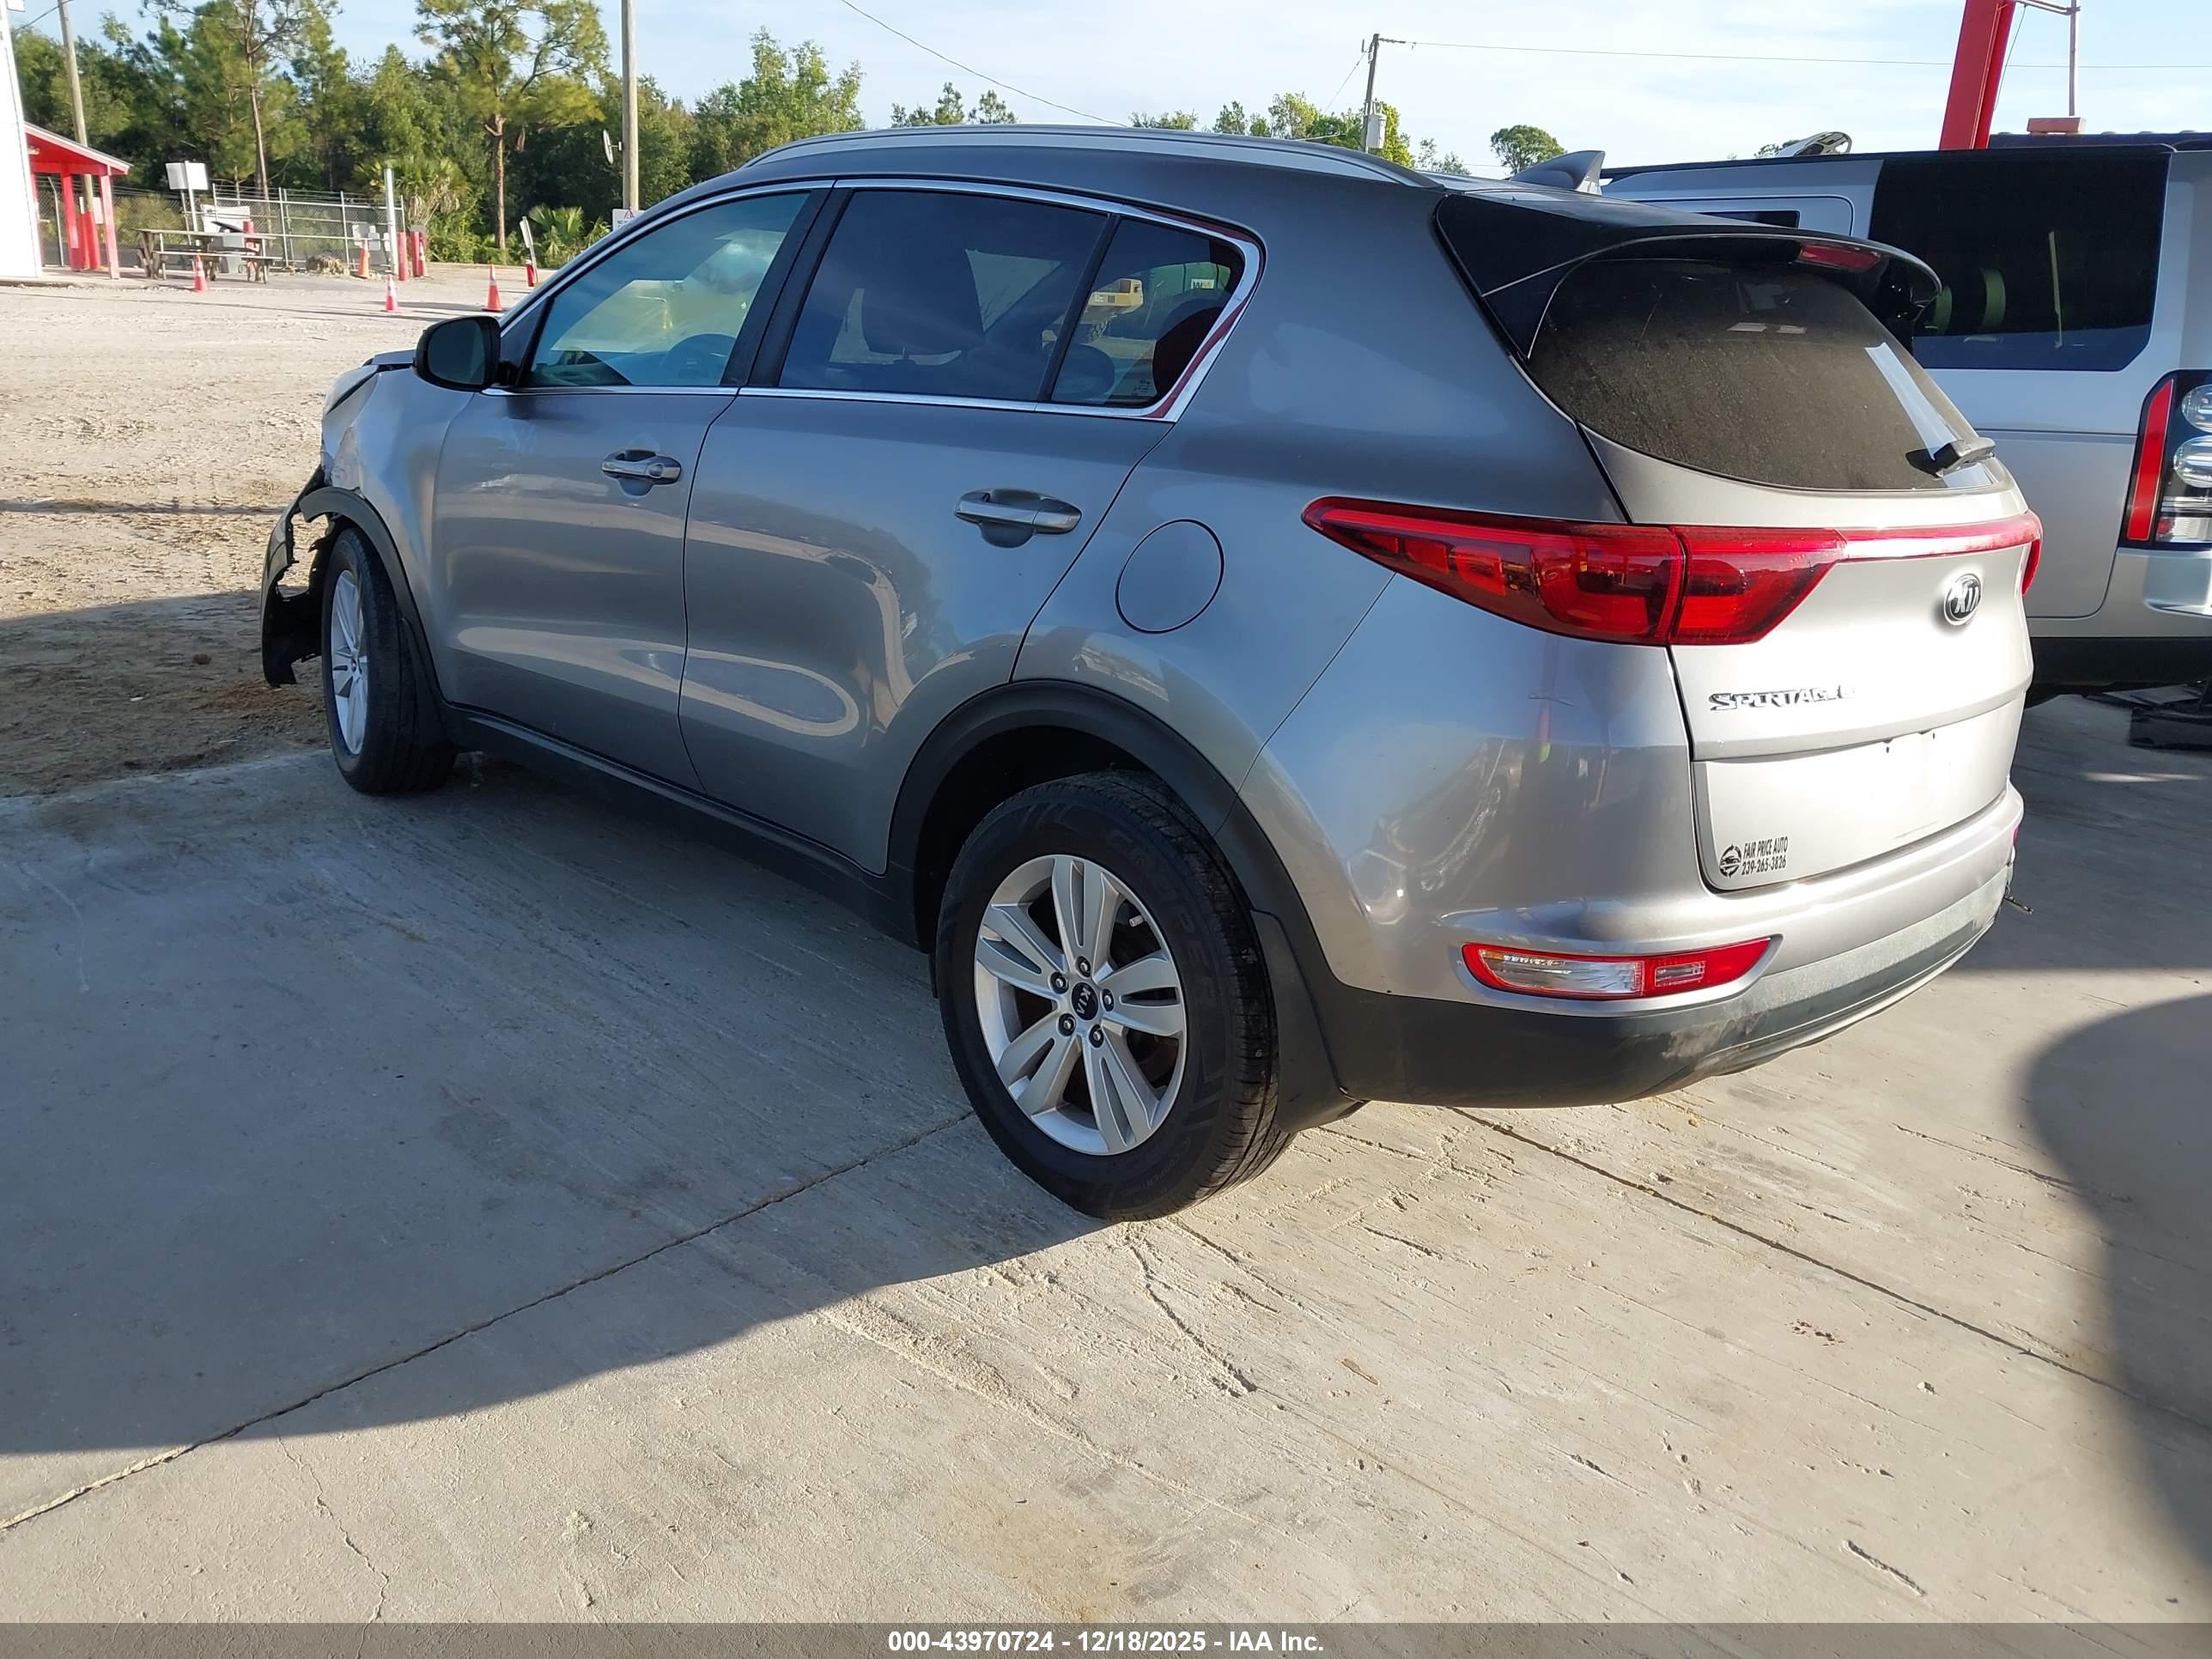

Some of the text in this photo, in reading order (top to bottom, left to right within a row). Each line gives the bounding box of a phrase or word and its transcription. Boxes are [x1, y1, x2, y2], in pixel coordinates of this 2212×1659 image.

[1952, 580, 1979, 613] KIA
[1743, 836, 1788, 860] FAIR PRICE AUTO
[1741, 854, 1787, 875] 239-265-3826
[1076, 988, 1091, 1014] KIA
